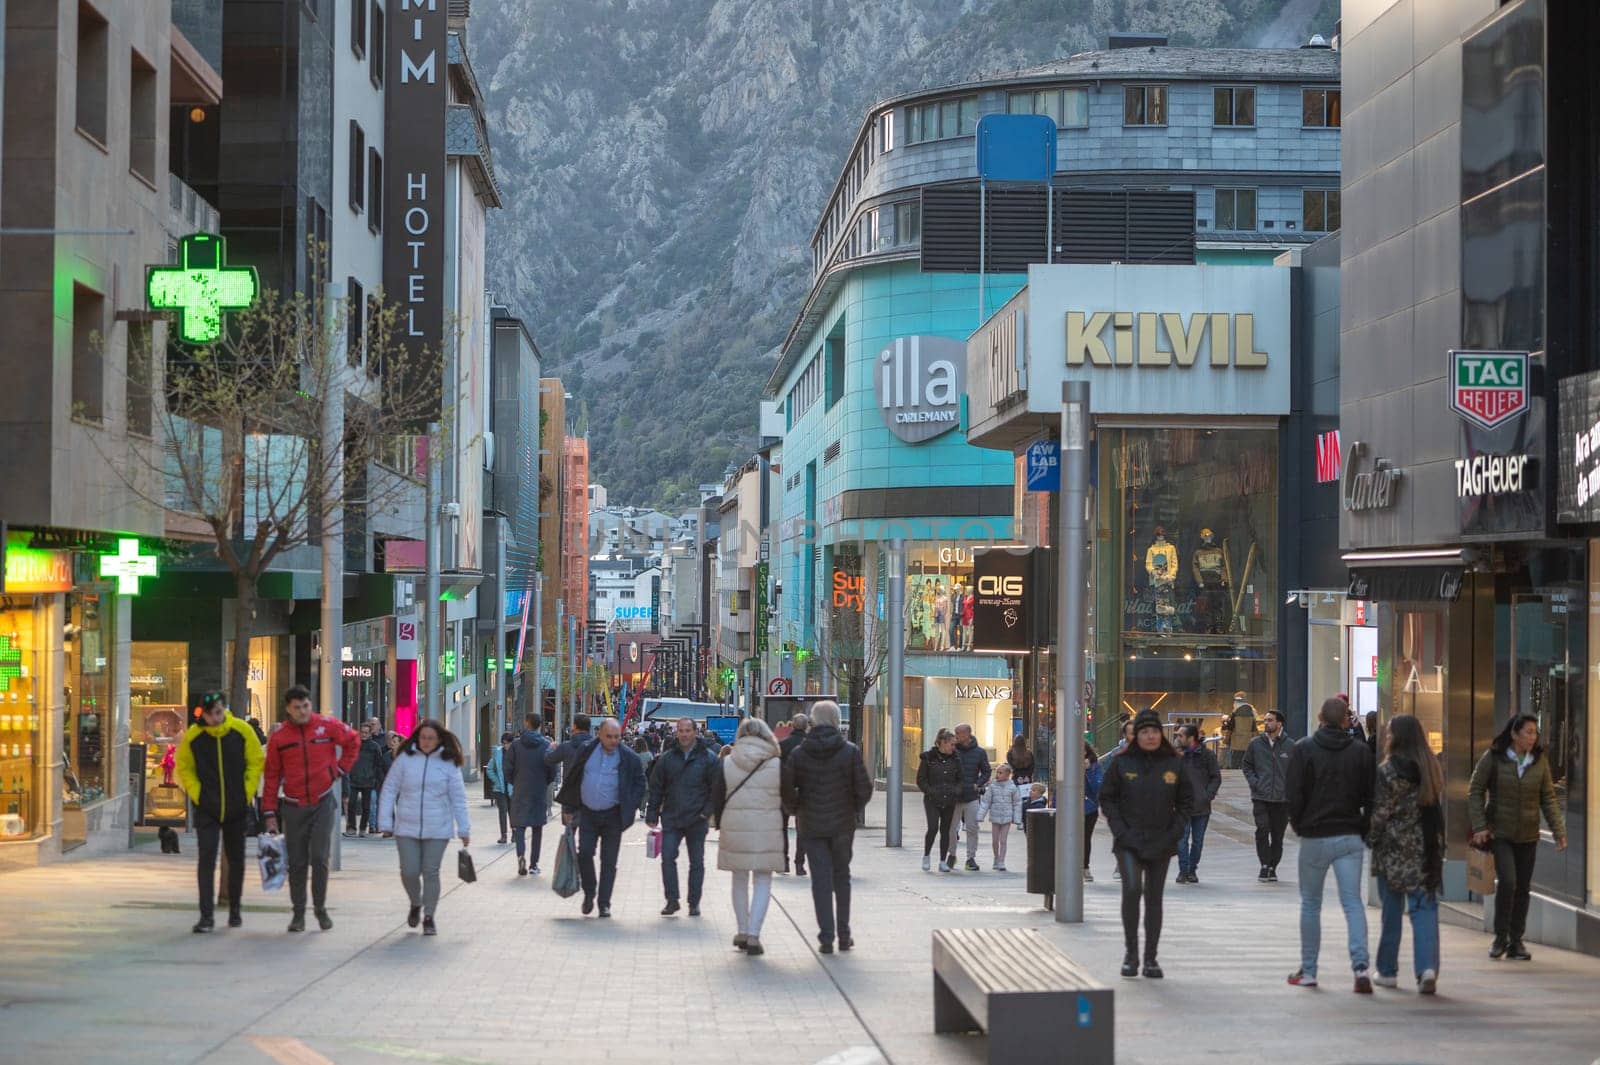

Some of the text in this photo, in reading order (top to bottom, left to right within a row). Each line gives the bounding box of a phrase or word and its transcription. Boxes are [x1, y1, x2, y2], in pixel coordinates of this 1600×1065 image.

[405, 173, 429, 336] HOTEL
[881, 336, 957, 408] illa
[1462, 360, 1519, 385] TAG
[896, 410, 956, 424] CARLEMANY
[1463, 391, 1520, 418] HEUER
[1032, 444, 1054, 456] AW
[1032, 456, 1057, 467] LAB
[759, 566, 768, 651] CAVA BENITO
[341, 665, 372, 678] rshka
